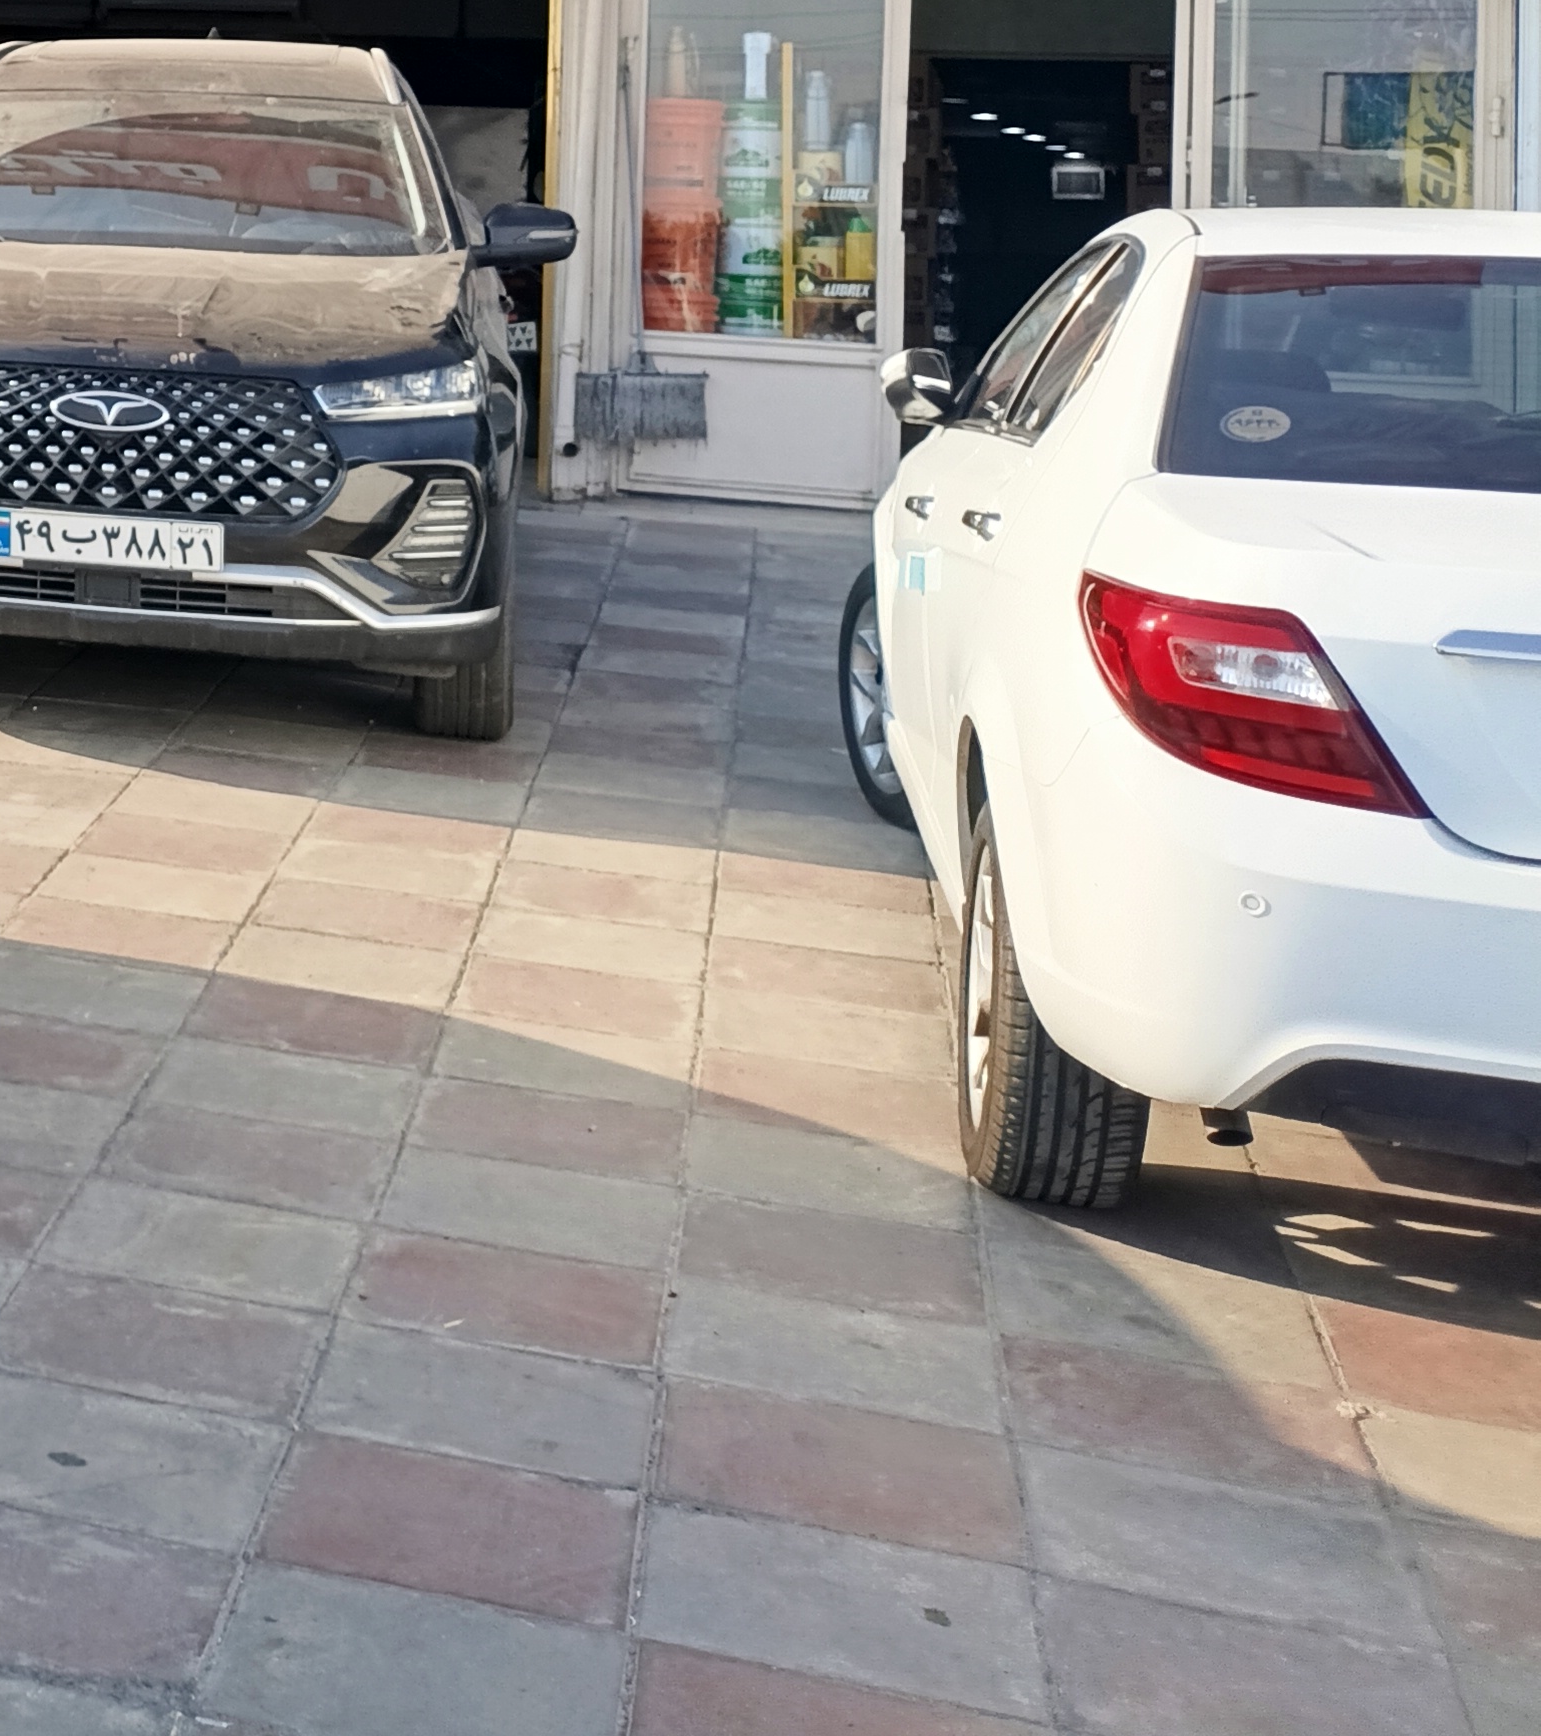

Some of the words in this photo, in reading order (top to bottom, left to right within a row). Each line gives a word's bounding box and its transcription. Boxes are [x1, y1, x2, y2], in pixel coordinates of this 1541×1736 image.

[15, 519, 56, 553] ۴۹
[61, 528, 98, 555] ب
[101, 525, 167, 561] ۳۸۸
[177, 536, 214, 567] ۲۱
